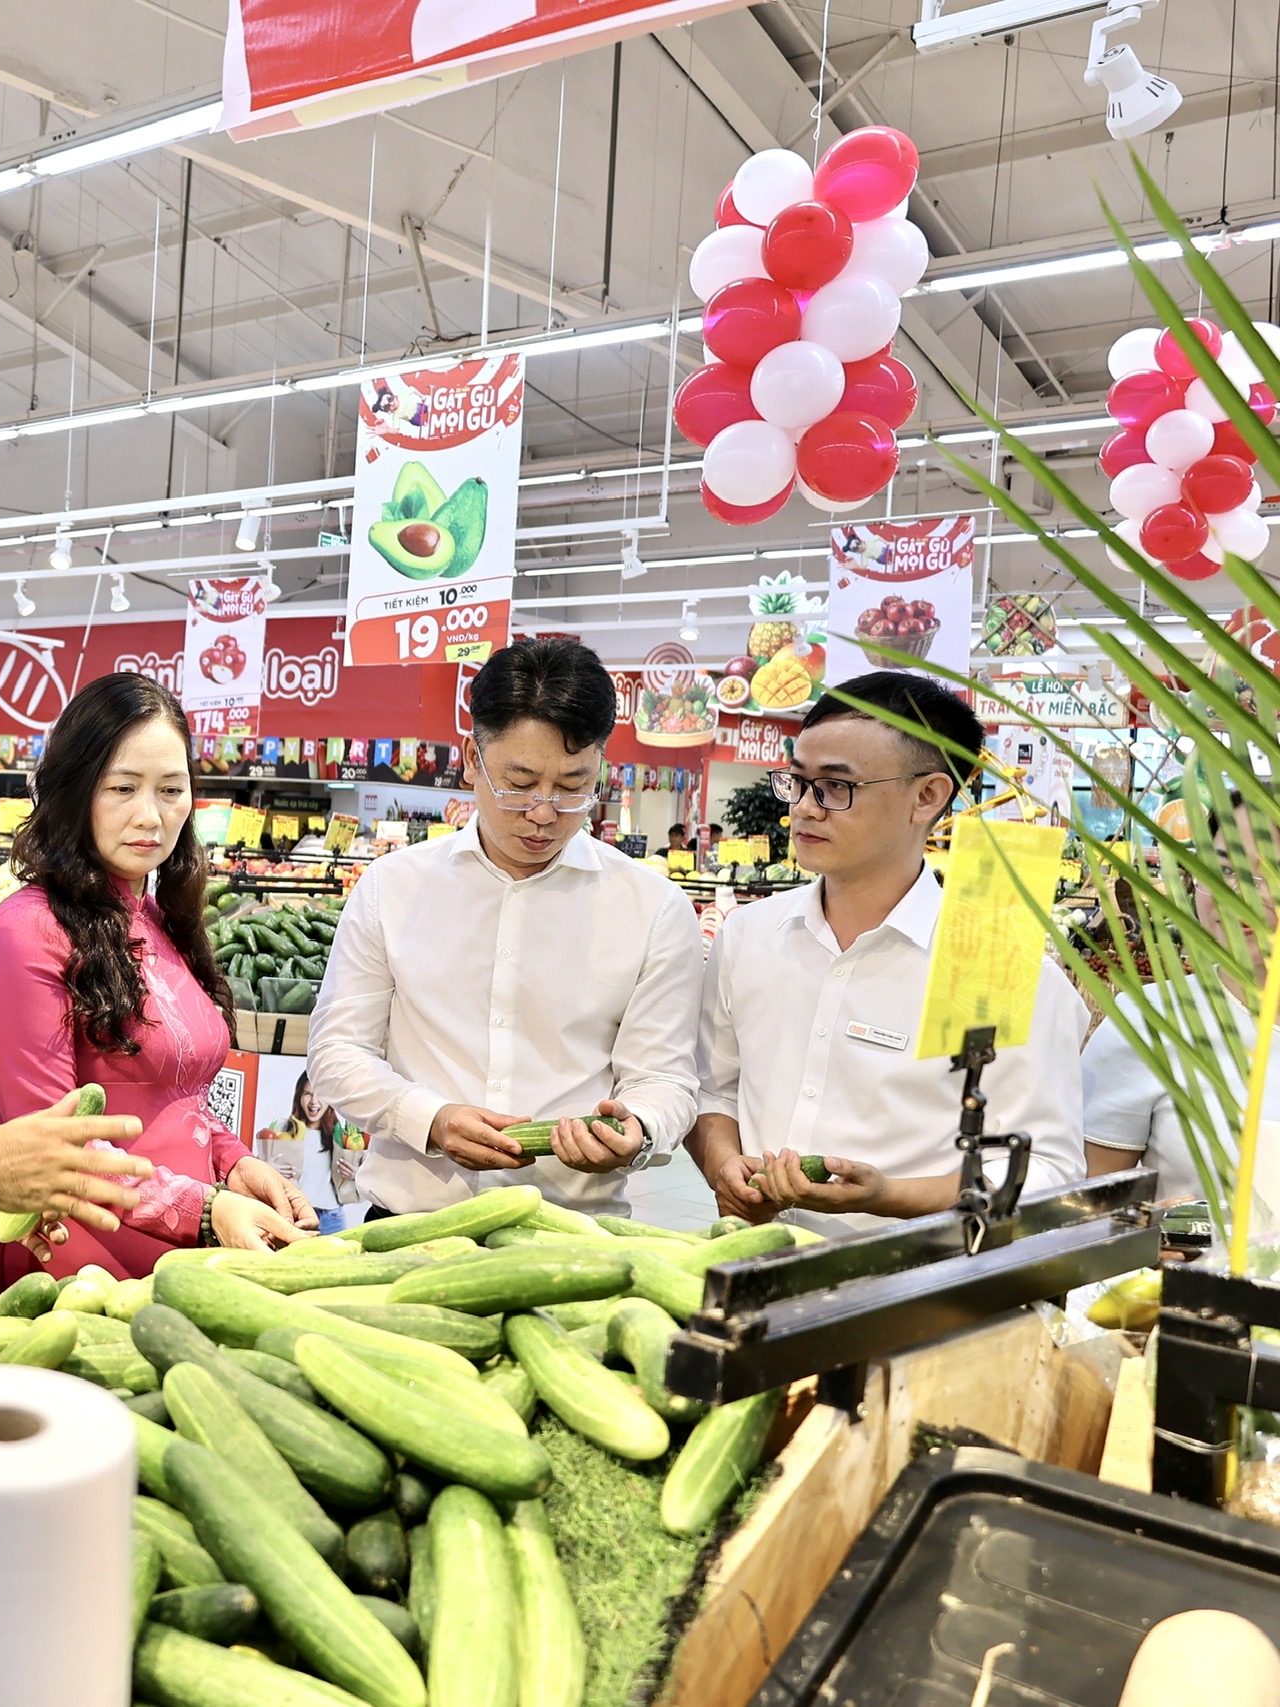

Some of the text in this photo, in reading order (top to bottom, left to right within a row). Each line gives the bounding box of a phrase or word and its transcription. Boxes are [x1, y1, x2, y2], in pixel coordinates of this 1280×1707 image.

[433, 385, 495, 412] GẬT GÙ
[430, 409, 464, 435] MỌI
[467, 406, 496, 431] GU
[896, 537, 950, 555] GẬT GÙ
[894, 553, 951, 572] MỌI GU
[384, 597, 403, 610] TIẾT
[406, 595, 428, 608] KIỆM
[447, 633, 479, 643] VND/kg
[271, 655, 332, 699] loại
